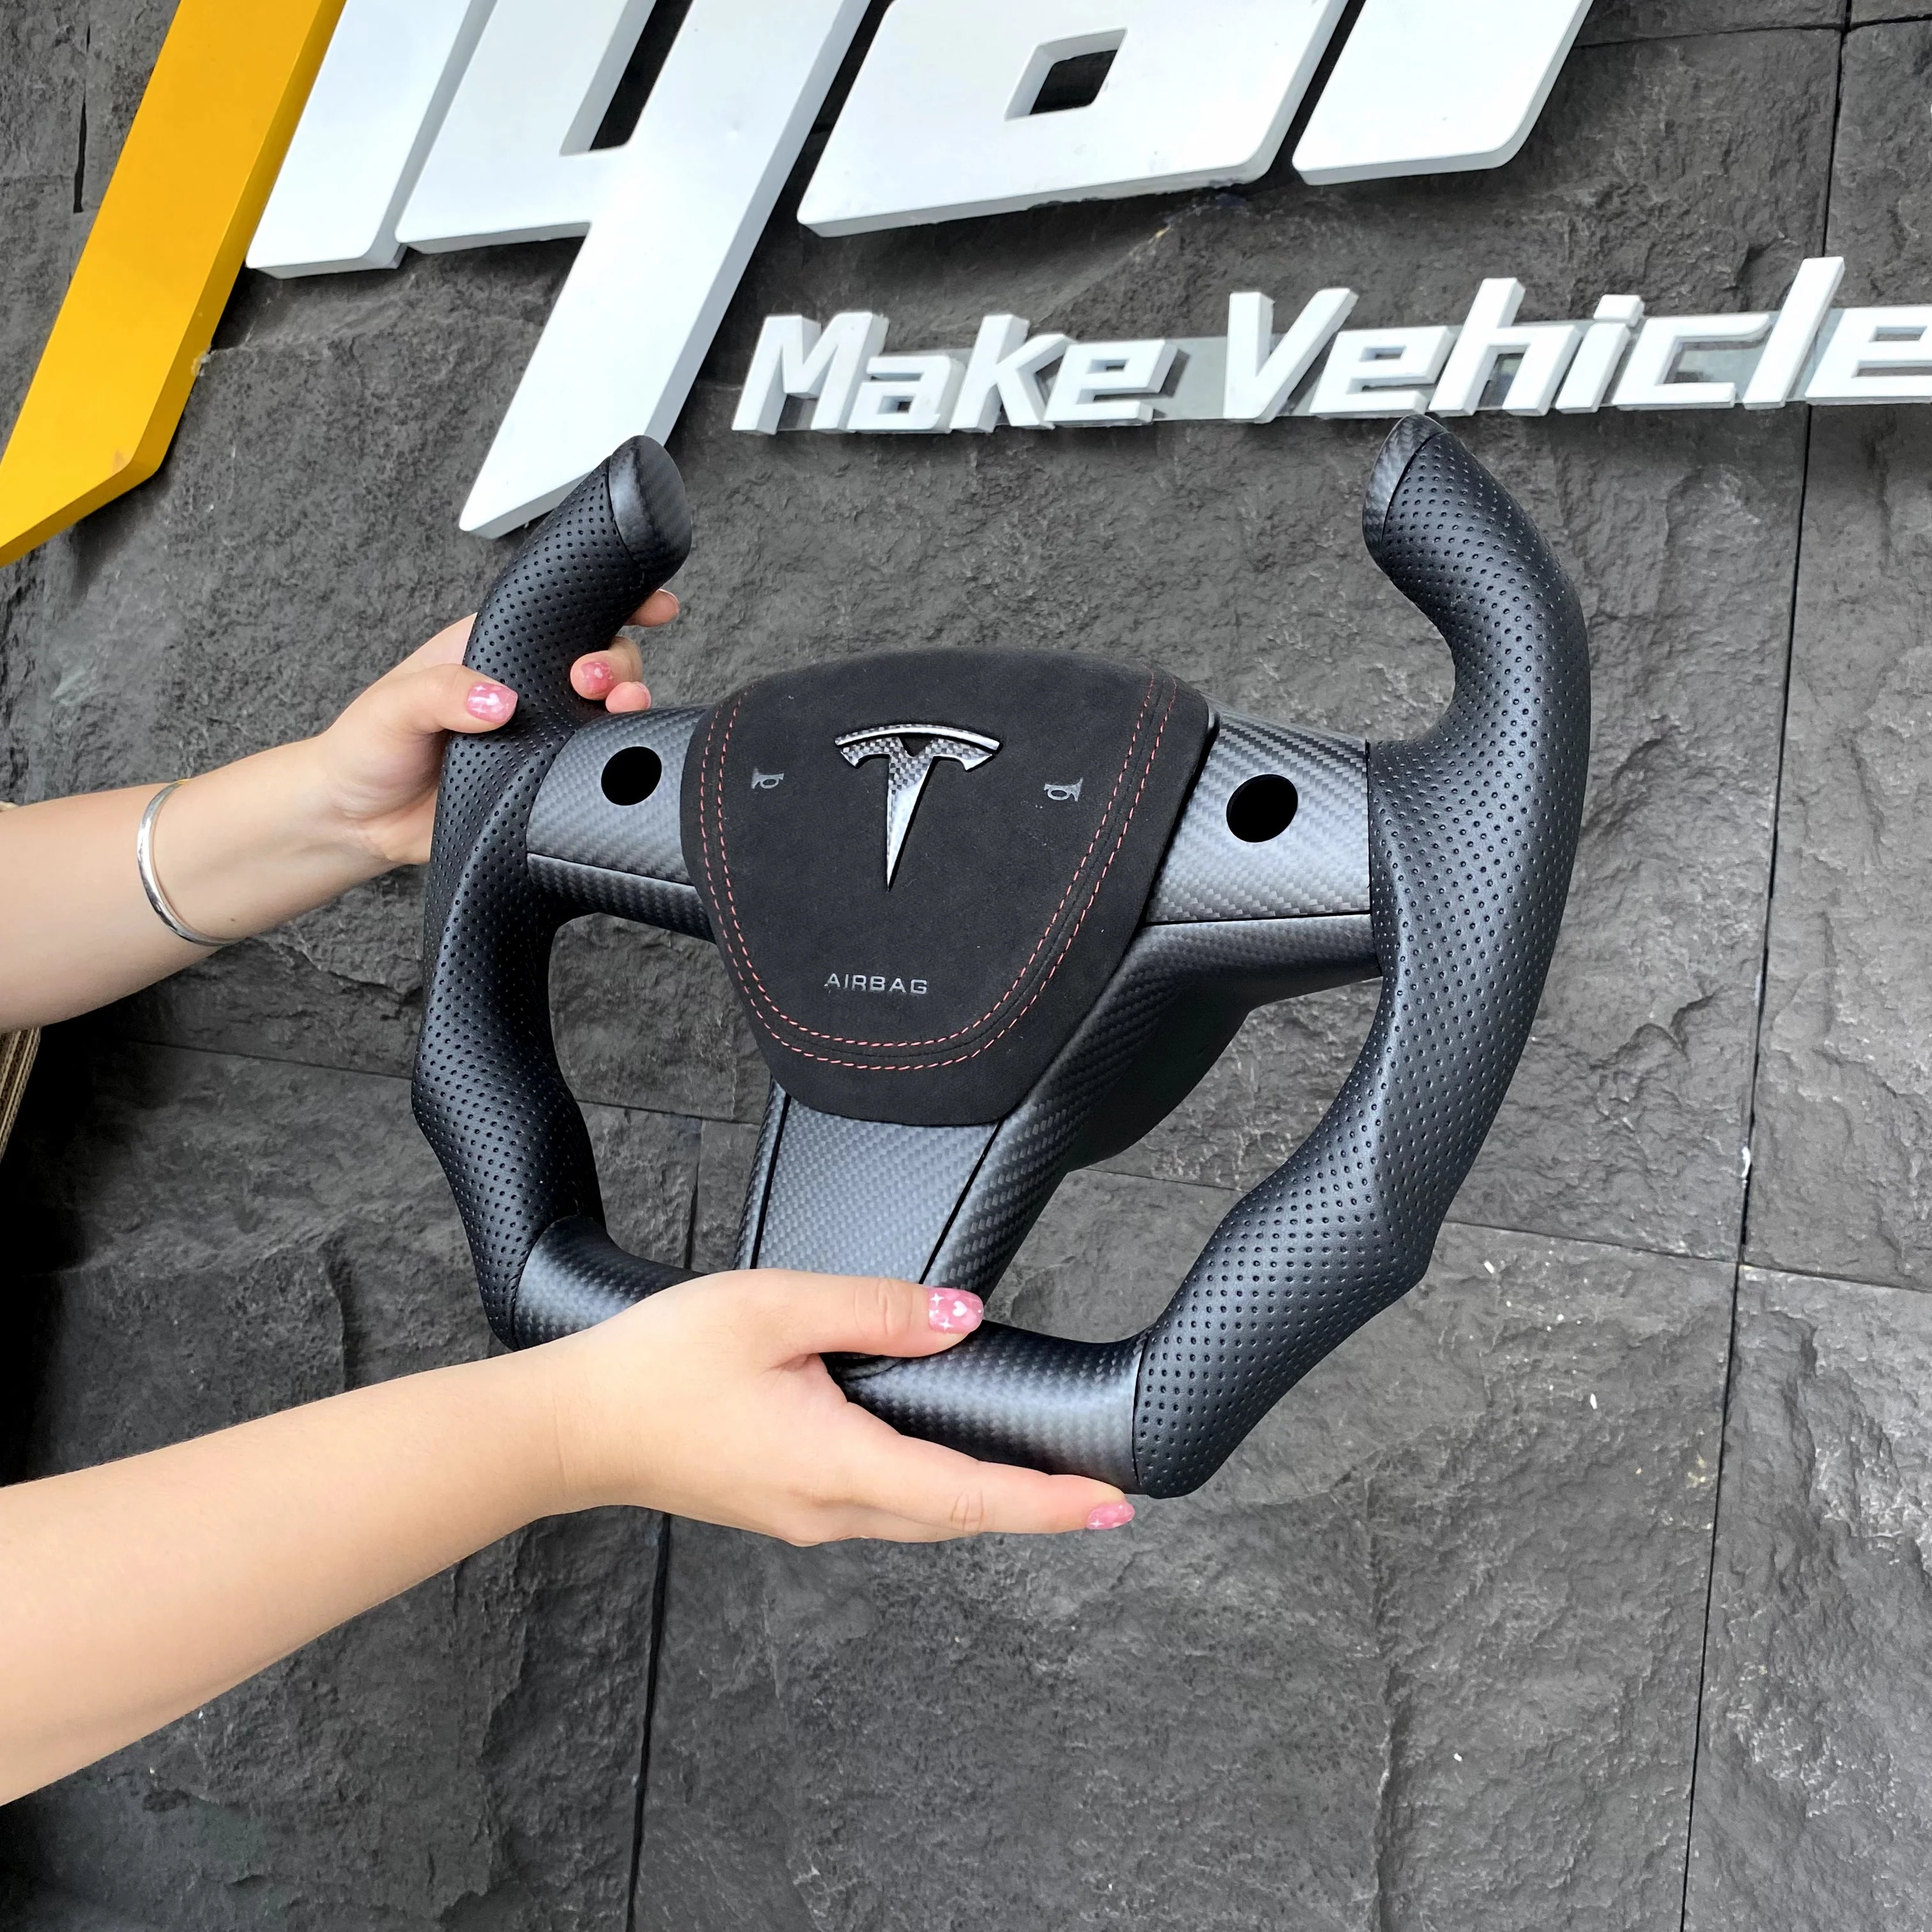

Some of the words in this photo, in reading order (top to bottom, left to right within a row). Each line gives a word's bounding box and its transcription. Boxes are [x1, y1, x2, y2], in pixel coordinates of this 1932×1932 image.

[732, 311, 1177, 434] Make
[1223, 257, 1932, 422] Vehicle
[824, 973, 928, 995] AIRBAG
